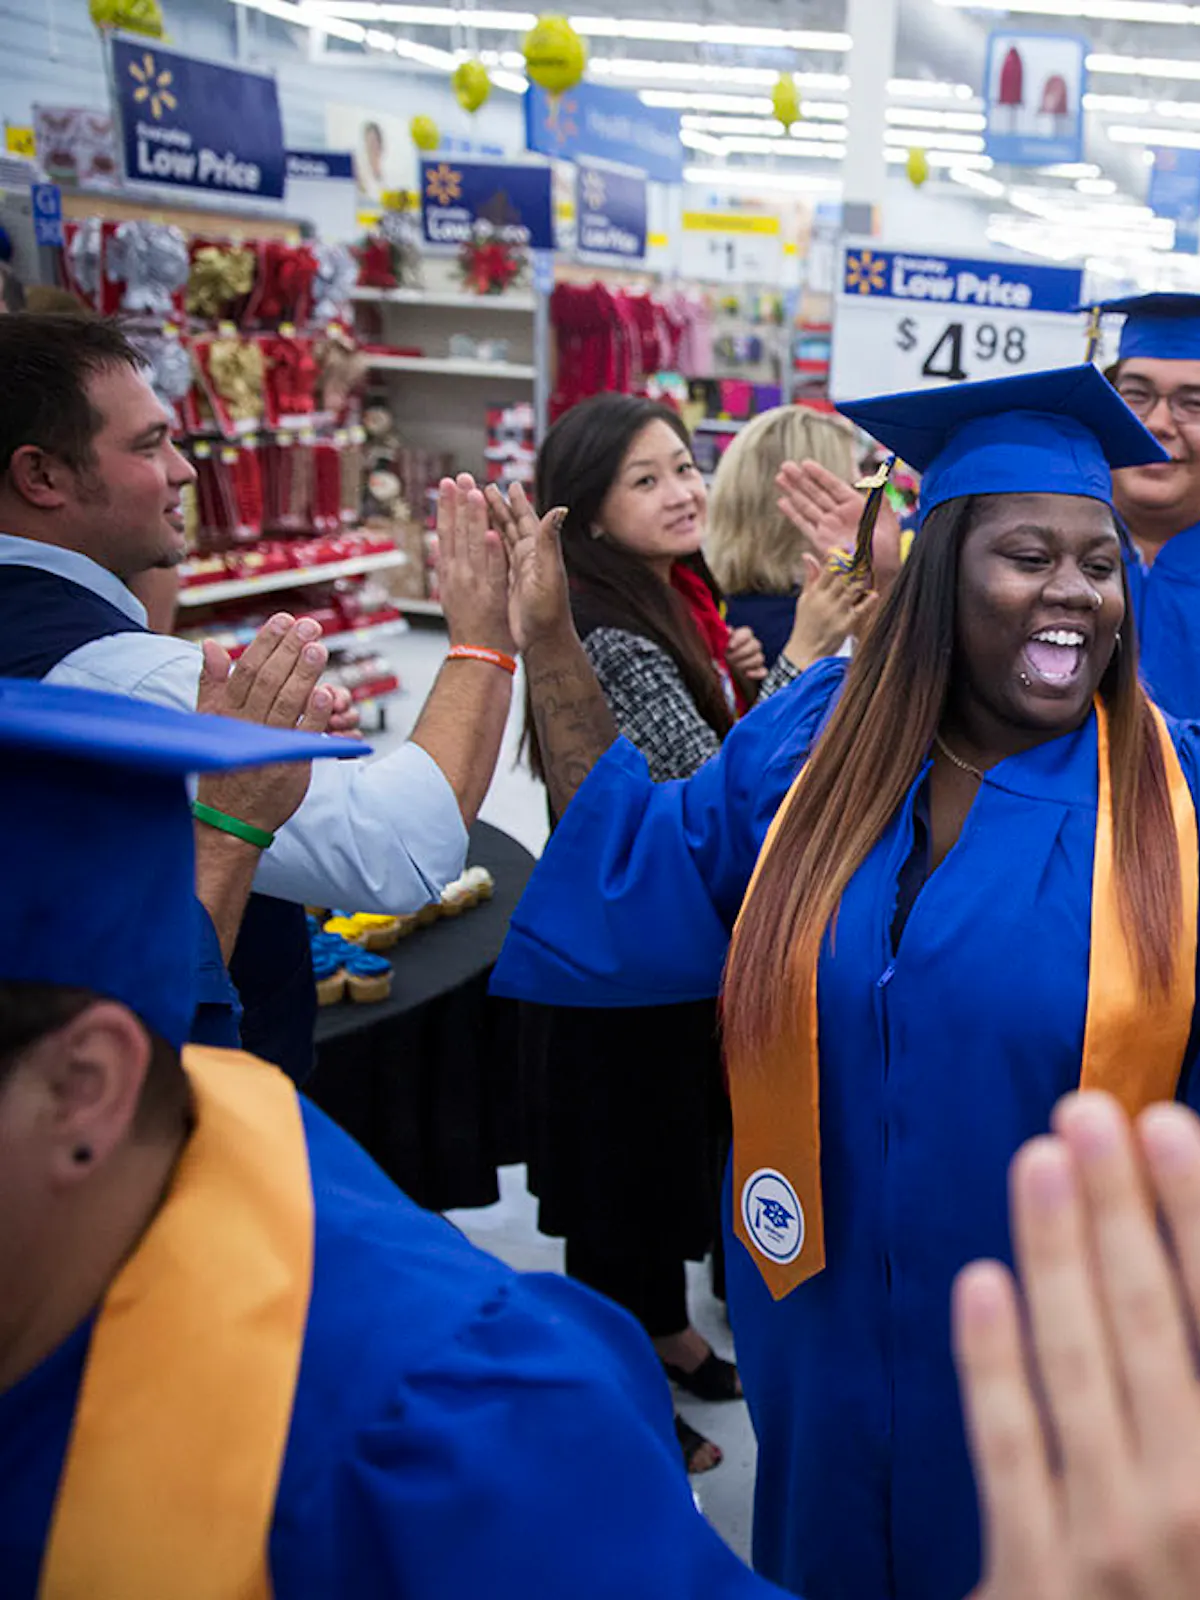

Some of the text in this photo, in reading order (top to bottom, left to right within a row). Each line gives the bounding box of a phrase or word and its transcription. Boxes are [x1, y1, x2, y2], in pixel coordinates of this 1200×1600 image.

[137, 139, 261, 191] Low Price
[892, 266, 1032, 308] Low Price
